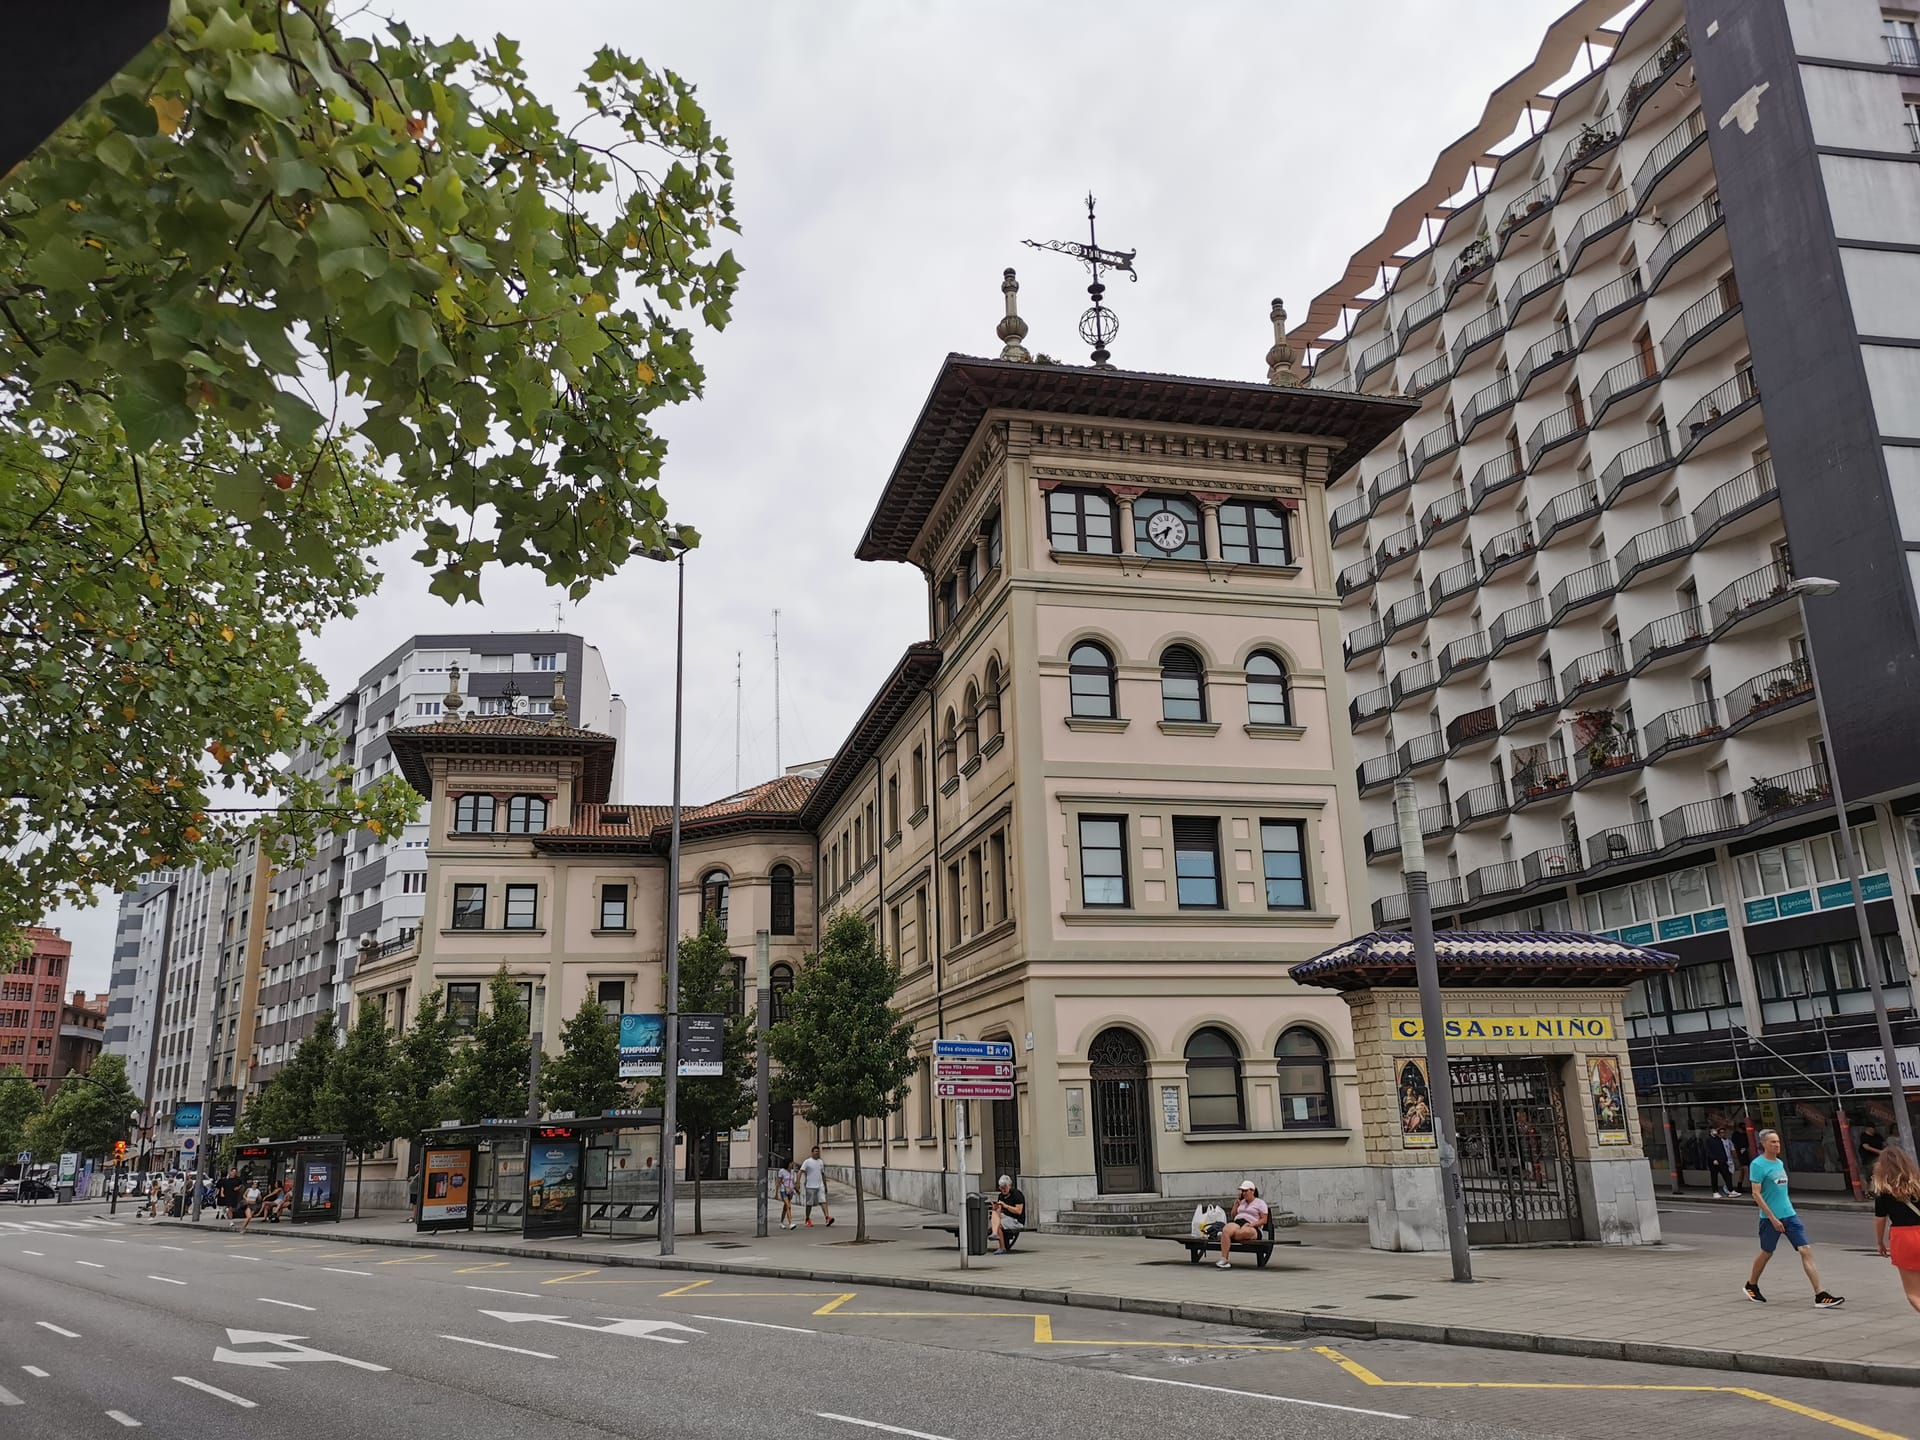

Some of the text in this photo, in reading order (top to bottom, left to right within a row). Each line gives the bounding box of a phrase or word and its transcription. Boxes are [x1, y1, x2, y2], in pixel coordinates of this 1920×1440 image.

[1398, 1018, 1604, 1038] CSA DEL NIÑO
[620, 1046, 661, 1054] SYMPHONY
[619, 1059, 663, 1068] CaixaForum
[678, 1058, 723, 1067] CaixaForum
[1853, 1061, 1919, 1082] HOTEL CRAL
